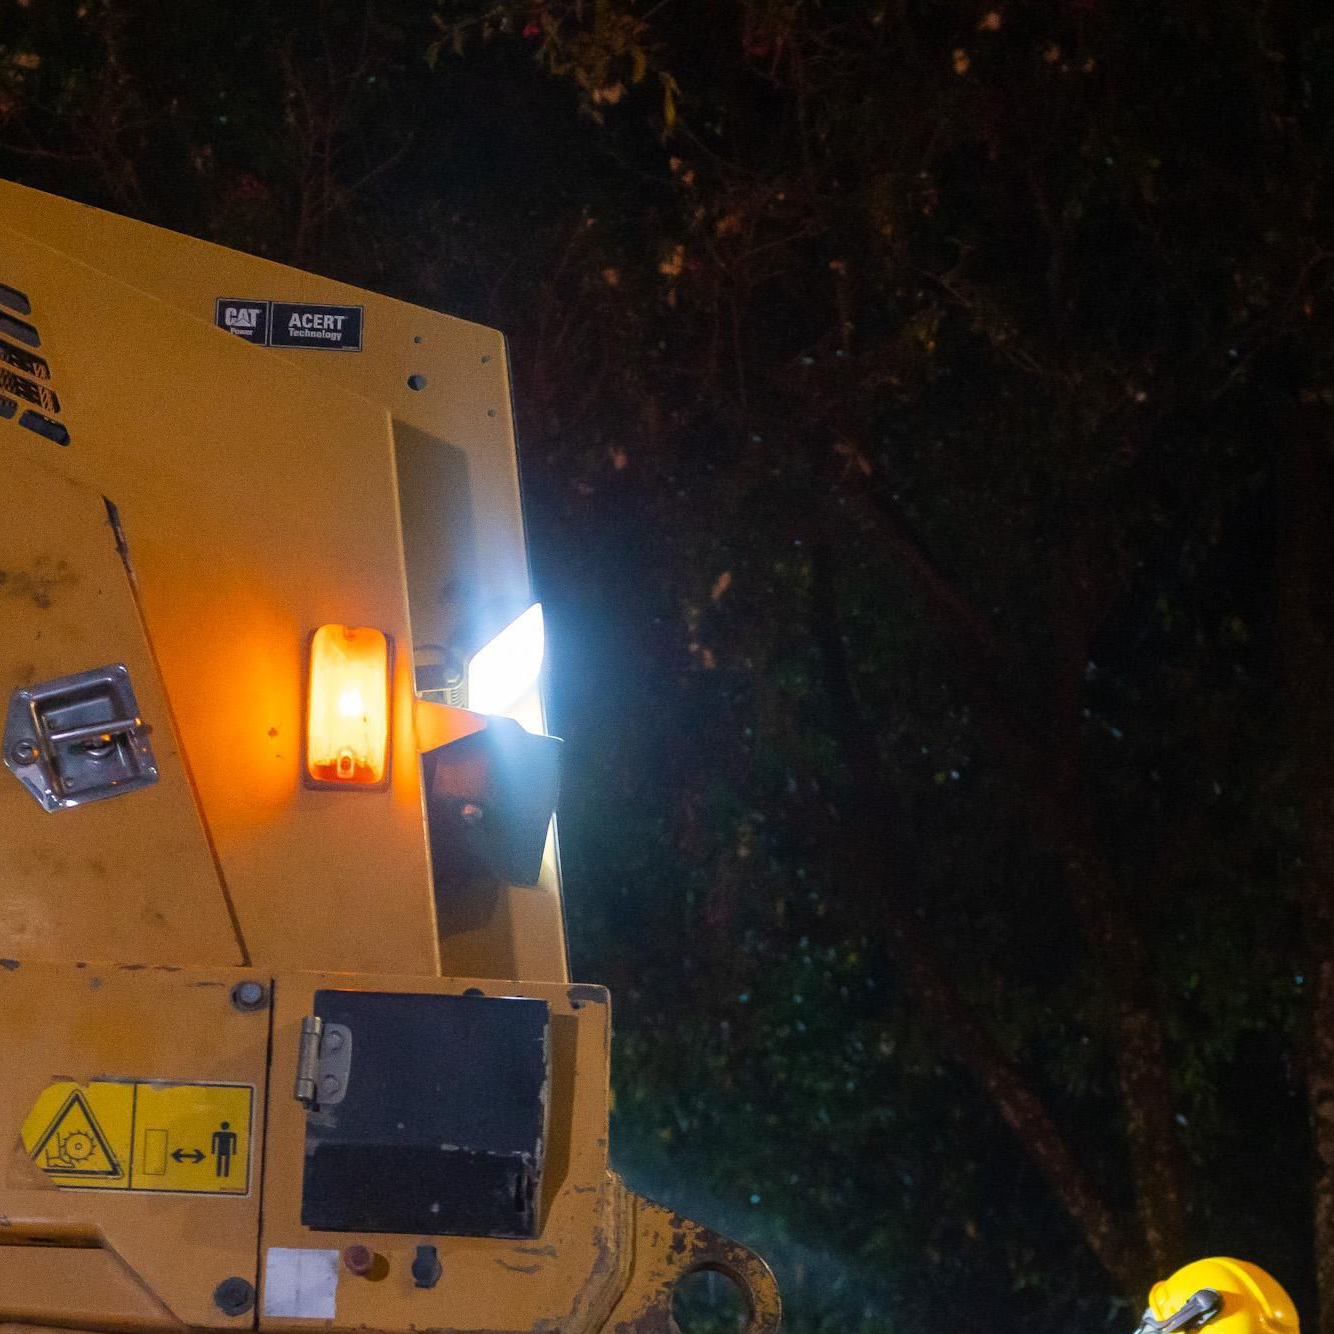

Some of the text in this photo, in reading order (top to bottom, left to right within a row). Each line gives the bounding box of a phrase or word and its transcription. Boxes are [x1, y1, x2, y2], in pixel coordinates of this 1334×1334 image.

[224, 307, 346, 330] CAT ACERT
[288, 328, 342, 341] Technology
